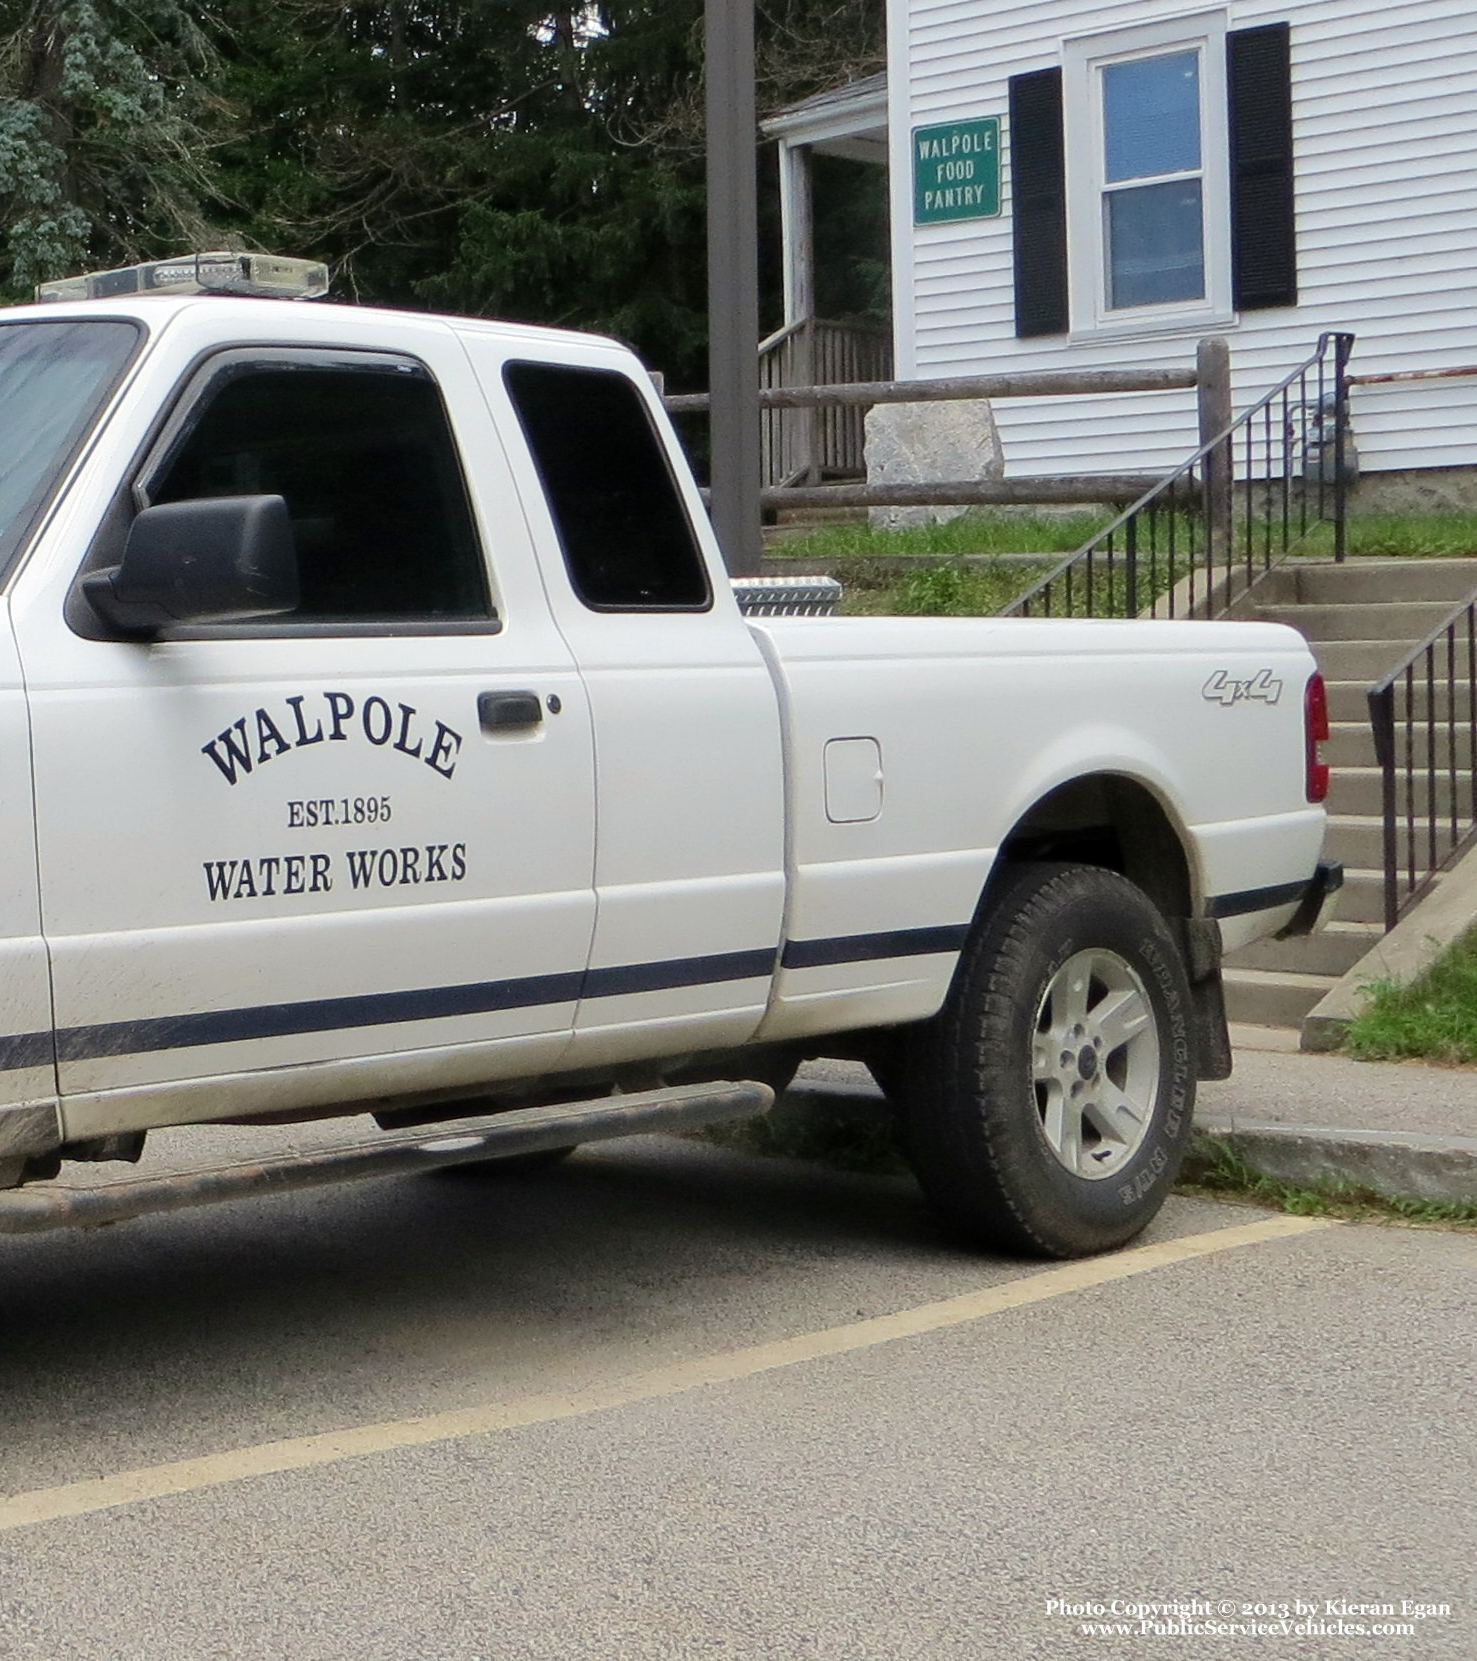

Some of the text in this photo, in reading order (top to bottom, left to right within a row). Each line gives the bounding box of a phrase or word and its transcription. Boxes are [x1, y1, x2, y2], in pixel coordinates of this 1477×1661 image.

[919, 130, 992, 160] WALPOLE
[937, 160, 974, 183] FOOD
[924, 184, 984, 210] PANTRY
[1202, 669, 1283, 706] 4x4
[201, 691, 463, 786] WALPOLE
[287, 796, 392, 828] EST.1895
[203, 843, 467, 901] WATER WORKS
